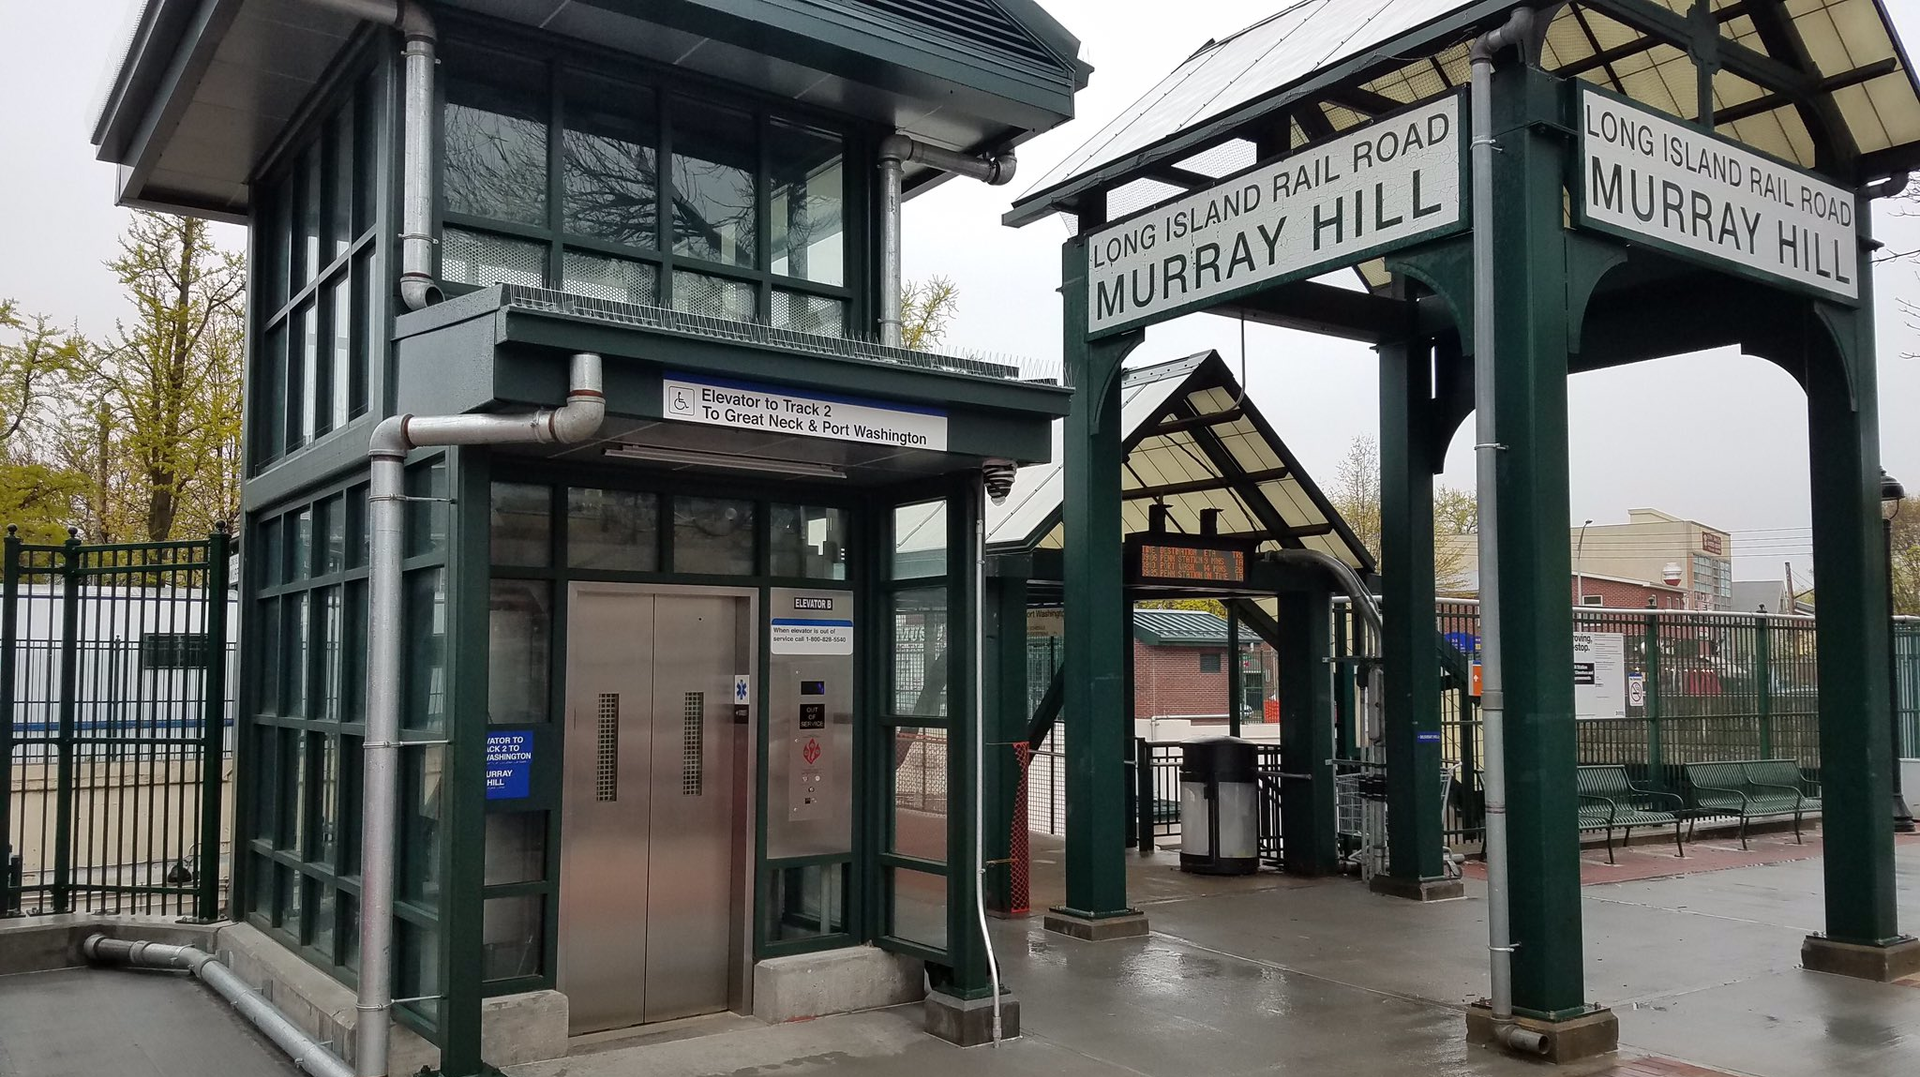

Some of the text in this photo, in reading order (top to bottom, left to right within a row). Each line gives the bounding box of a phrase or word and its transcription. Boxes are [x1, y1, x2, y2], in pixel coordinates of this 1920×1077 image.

[1586, 104, 1851, 227] LONG ISLAND RAIL ROAD
[1094, 112, 1450, 269] LONG ISLAND RAIL ROAD
[1591, 155, 1850, 285] MURRAY HILL
[1096, 169, 1442, 321] MURRAY HILL
[702, 388, 832, 418] Elevator to Track 2
[702, 405, 927, 446] To Great Neck & Port Washington
[795, 598, 832, 609] ELEVATOR B
[509, 744, 520, 752] TO
[512, 736, 524, 744] TO
[486, 769, 513, 778] URRAY
[487, 778, 505, 786] HILL
